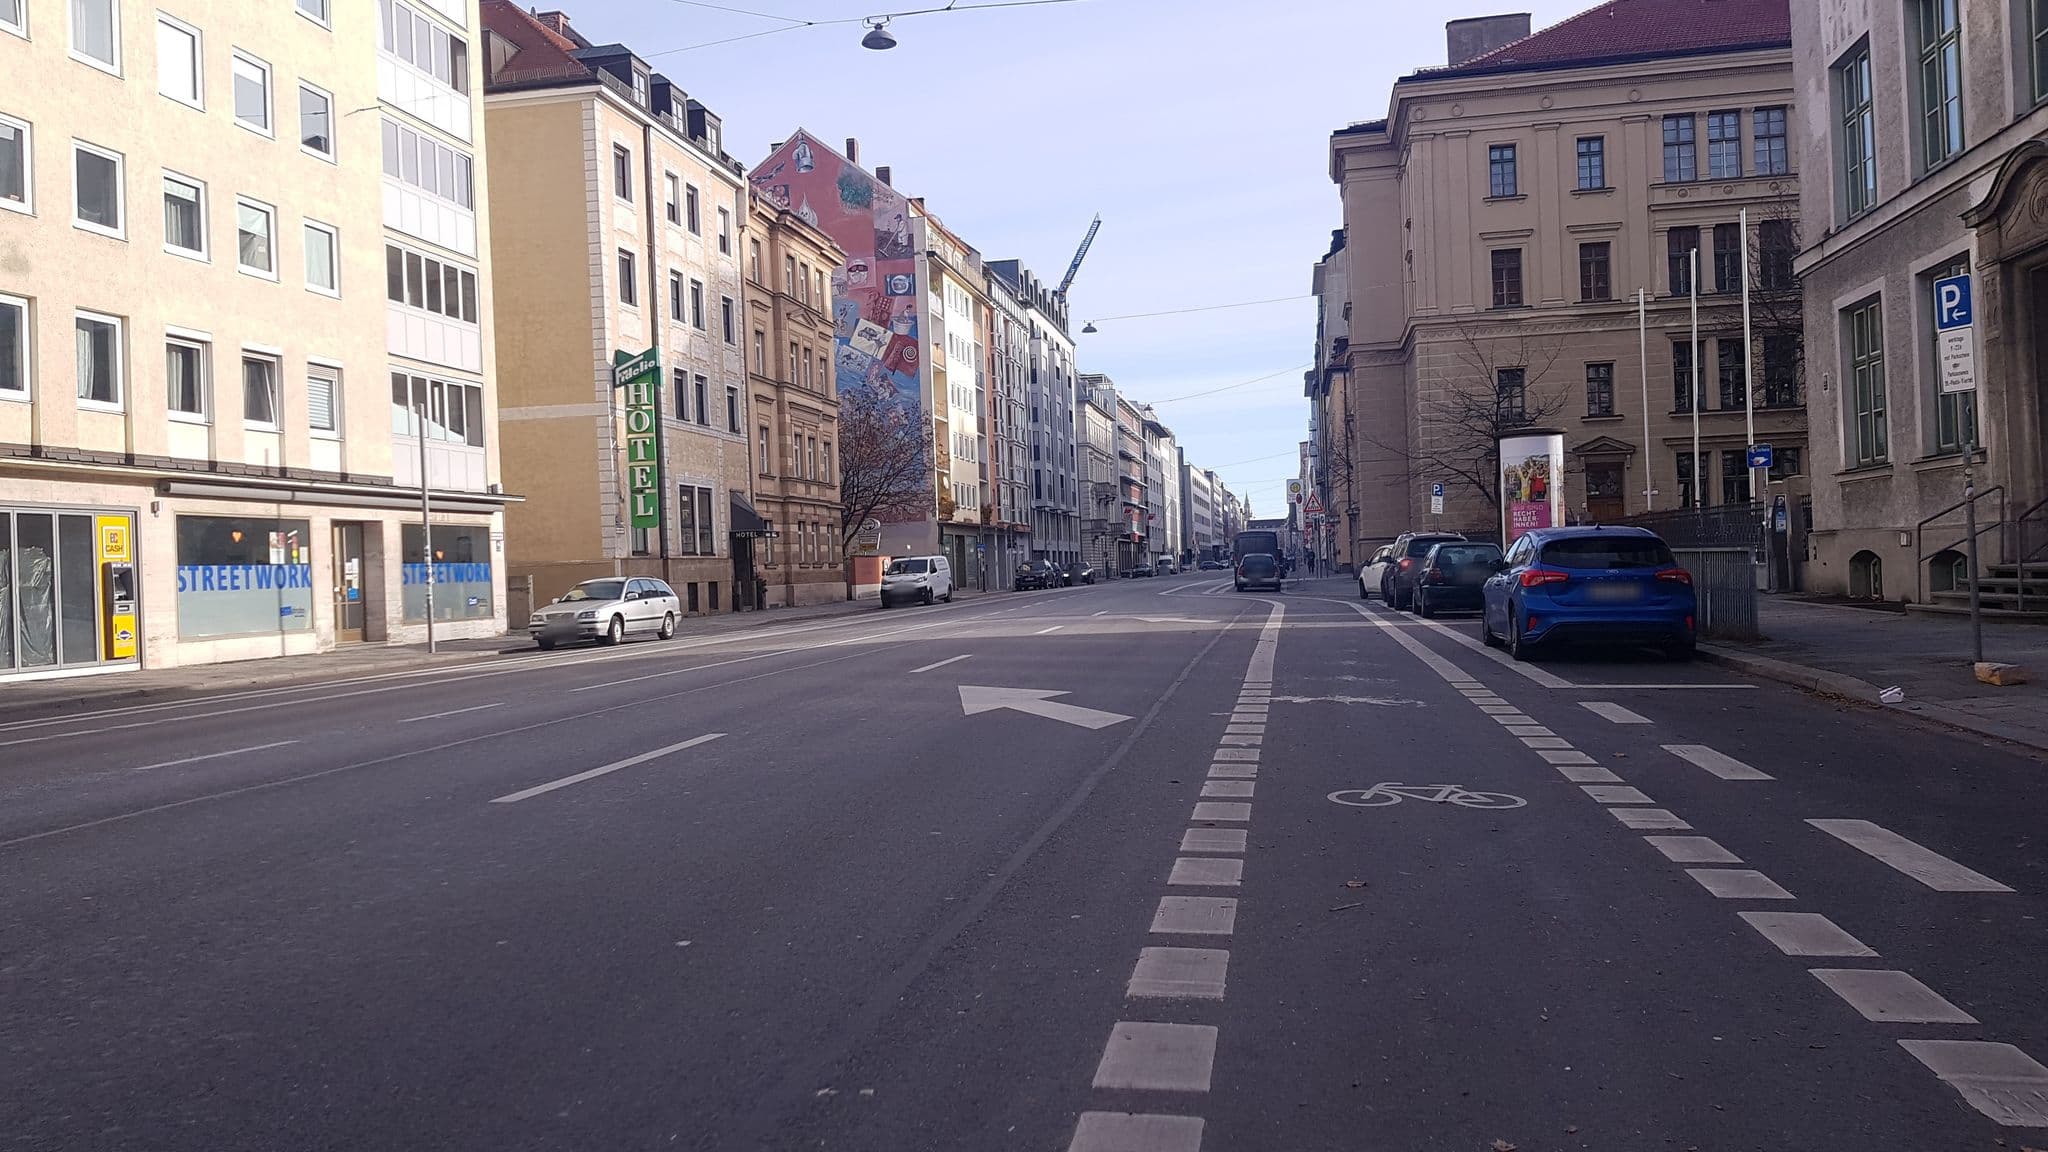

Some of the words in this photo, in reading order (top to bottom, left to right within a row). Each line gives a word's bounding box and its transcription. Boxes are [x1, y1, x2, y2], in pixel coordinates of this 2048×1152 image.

[1941, 284, 1961, 323] P
[627, 382, 654, 517] HOTEL
[105, 544, 123, 552] CASH
[177, 564, 312, 593] STREETWORK
